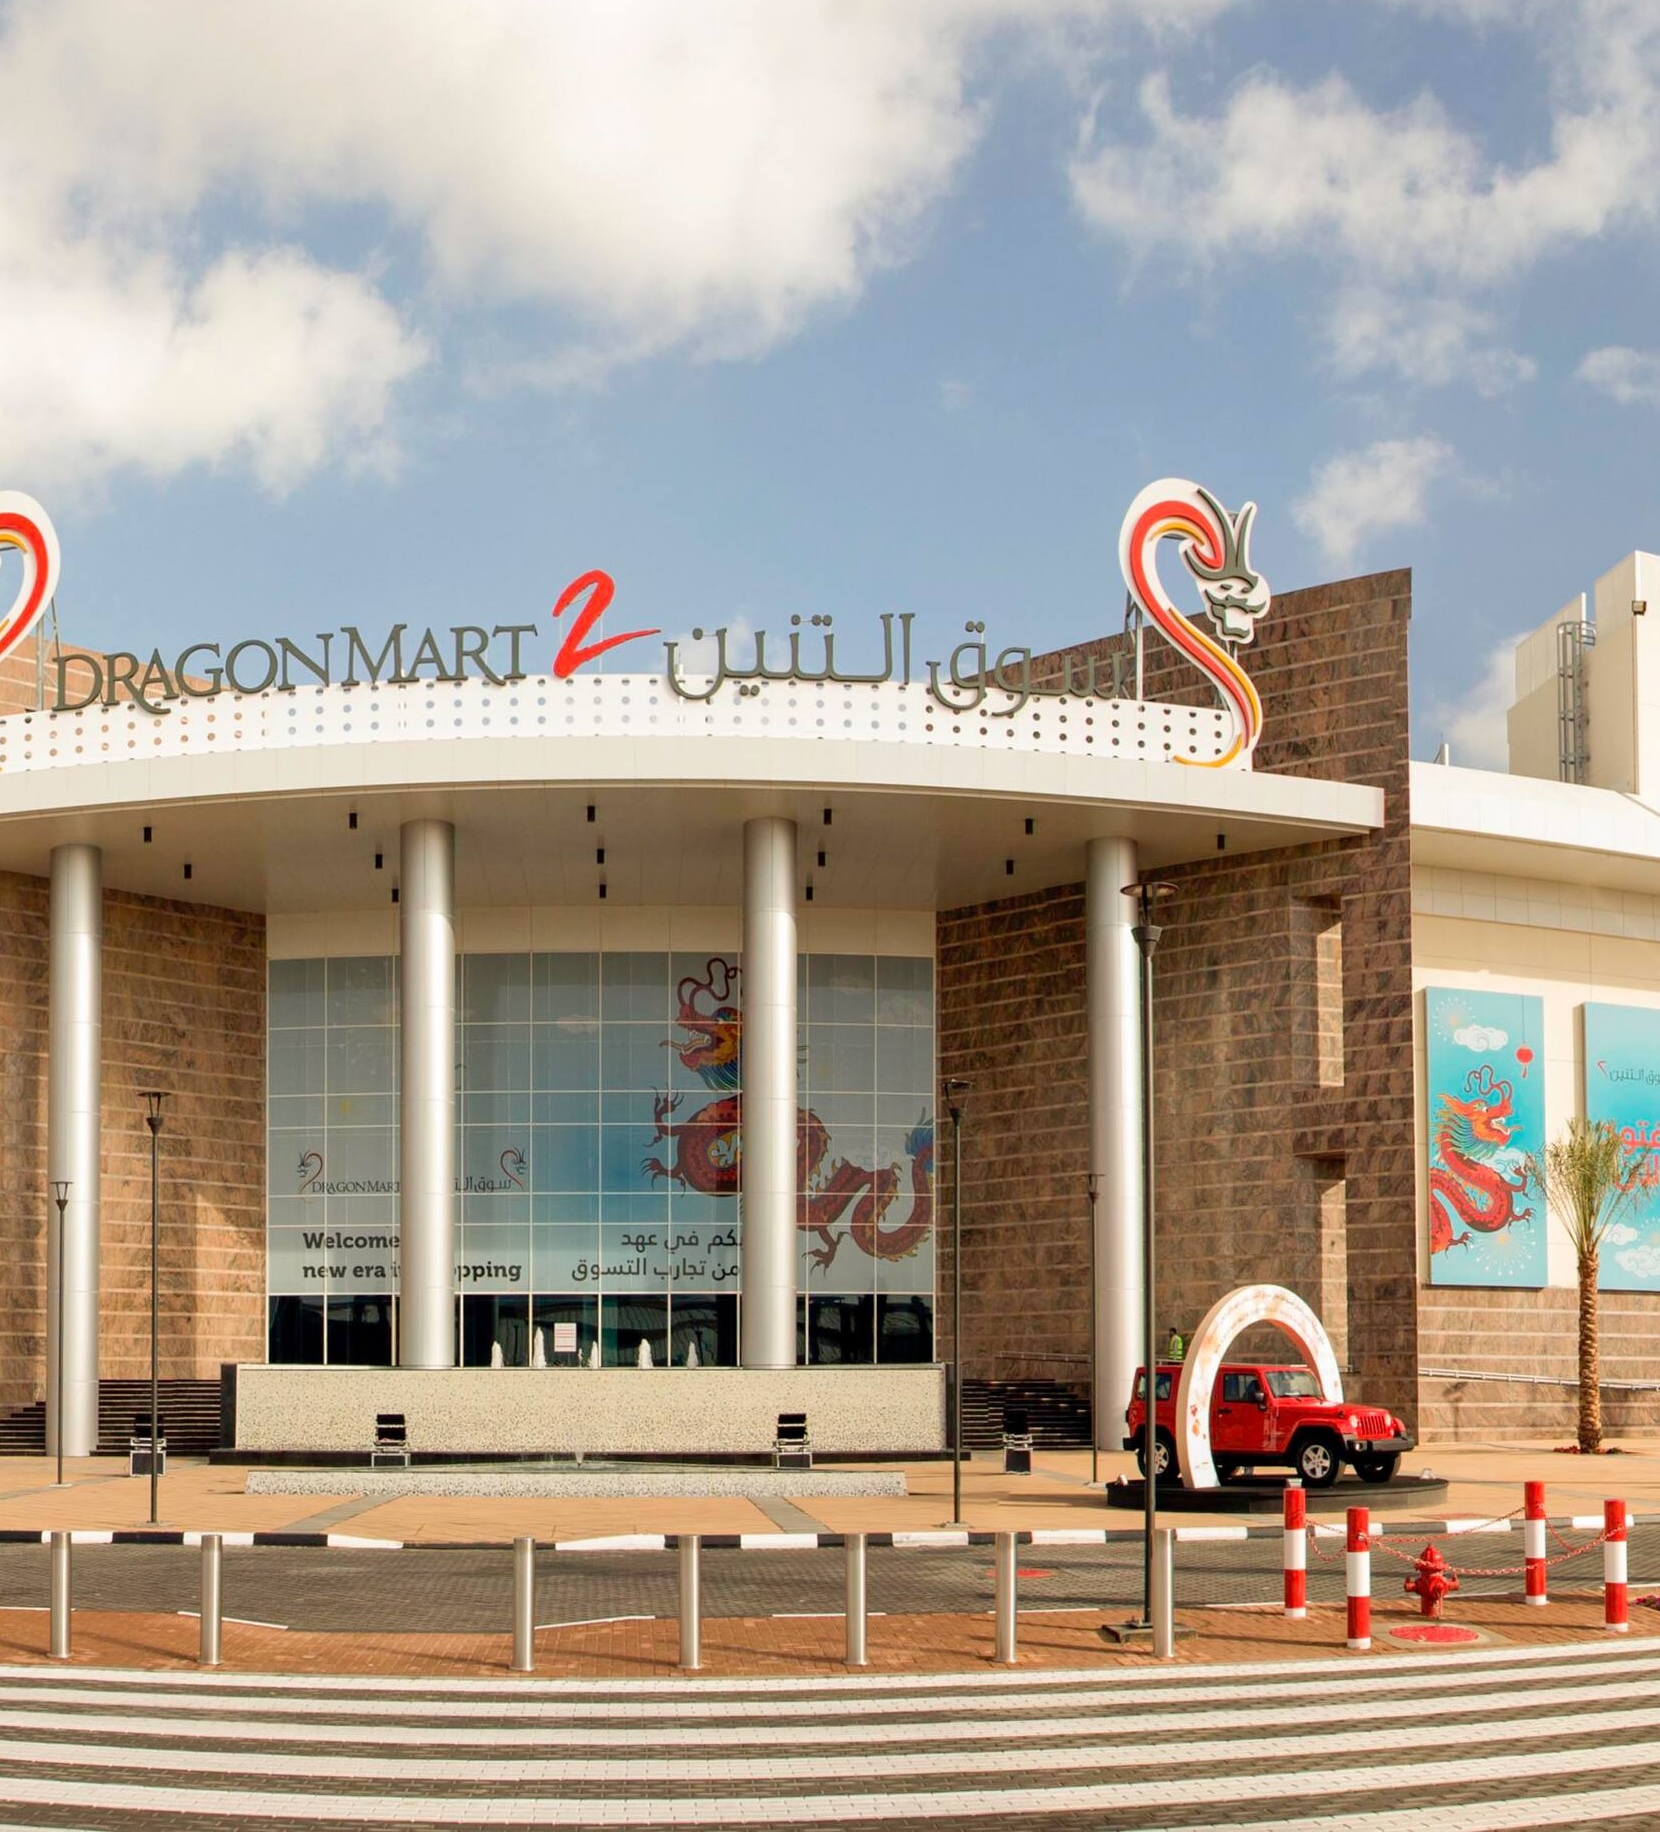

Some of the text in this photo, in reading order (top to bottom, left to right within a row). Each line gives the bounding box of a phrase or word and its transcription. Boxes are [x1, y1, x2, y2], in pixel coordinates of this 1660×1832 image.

[552, 569, 661, 678] 2
[663, 613, 1127, 716] سوق التنين
[474, 1176, 512, 1193] سوق
[303, 1232, 400, 1249] Welcome
[621, 1233, 657, 1253] عهد
[664, 1231, 700, 1254] في
[303, 1265, 347, 1279] new
[353, 1265, 387, 1279] era
[571, 1257, 647, 1282] التسوق
[654, 1258, 707, 1281] تجارب
